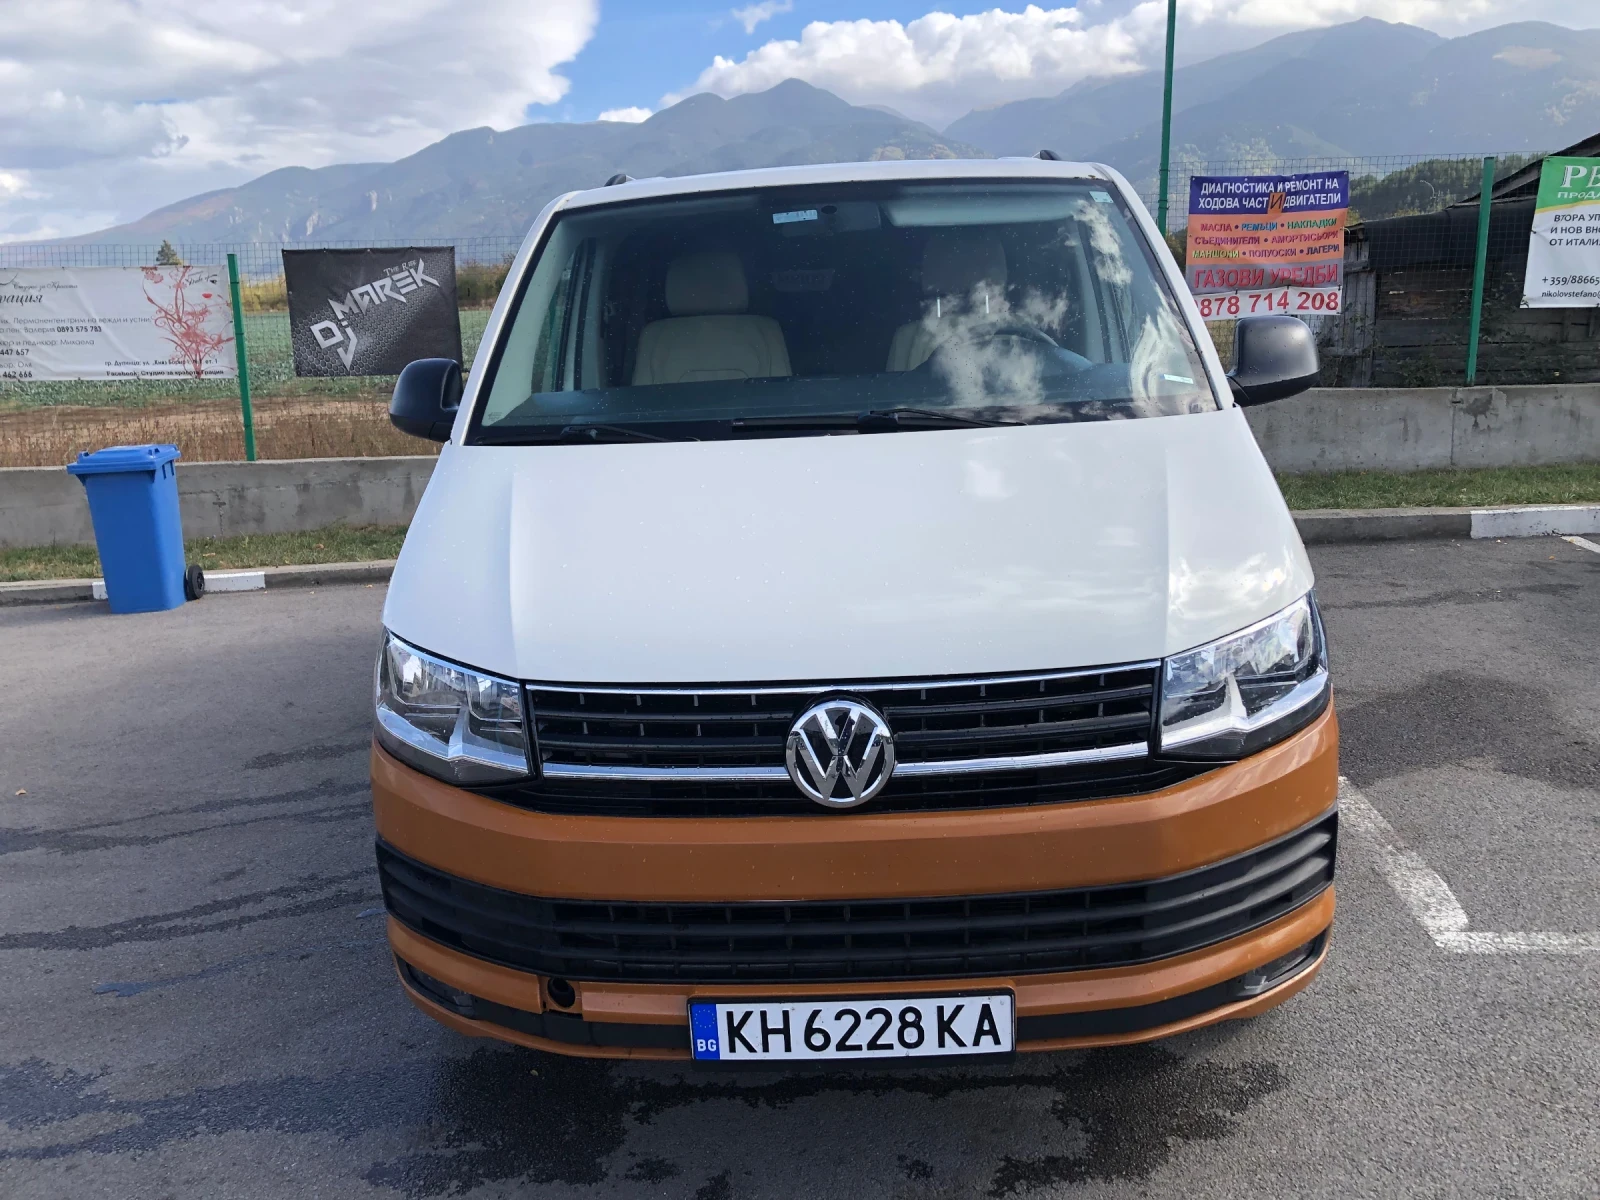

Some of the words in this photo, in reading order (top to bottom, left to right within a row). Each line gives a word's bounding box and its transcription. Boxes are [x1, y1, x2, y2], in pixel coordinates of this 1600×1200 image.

[1201, 181, 1274, 195] ДИАГНОСТИКА
[1277, 182, 1283, 193] И
[1285, 179, 1322, 192] РЕМОНТ
[1325, 178, 1339, 190] НА
[1198, 198, 1240, 211] ХОДОВА
[1242, 197, 1268, 209] ЧАСТ
[1283, 192, 1341, 208] ДВИГАТЕЛИ
[1554, 214, 1585, 222] ВТОРА
[1200, 223, 1232, 232] МАСЛА
[1287, 218, 1337, 230] НАКЛАДКИ
[1550, 226, 1558, 234] И
[1560, 226, 1583, 234] НОВ
[1585, 226, 1600, 234] ВН
[1194, 235, 1260, 246] СЪЕДИНИТЕЛИ
[1549, 238, 1564, 247] ОТ
[1566, 238, 1600, 246] ИТАЛИ
[1192, 250, 1239, 259] МАНШОНИ
[1249, 248, 1297, 258] ПОЛУОСКИ
[1305, 244, 1340, 256] ЛАГЕРИ
[1194, 268, 1265, 289] ГАЗОВИ
[1269, 263, 1338, 287] УРЕДБИ
[1196, 295, 1240, 318] 878
[1248, 291, 1289, 313] 714
[1297, 291, 1339, 311] 208
[56, 325, 74, 333] 0893
[75, 325, 88, 333] 575
[90, 325, 102, 333] 783
[15, 348, 29, 356] 657
[725, 1009, 792, 1053] KH
[803, 1006, 925, 1052] 6228
[936, 1003, 1002, 1049] KA
[696, 1039, 717, 1052] BG
